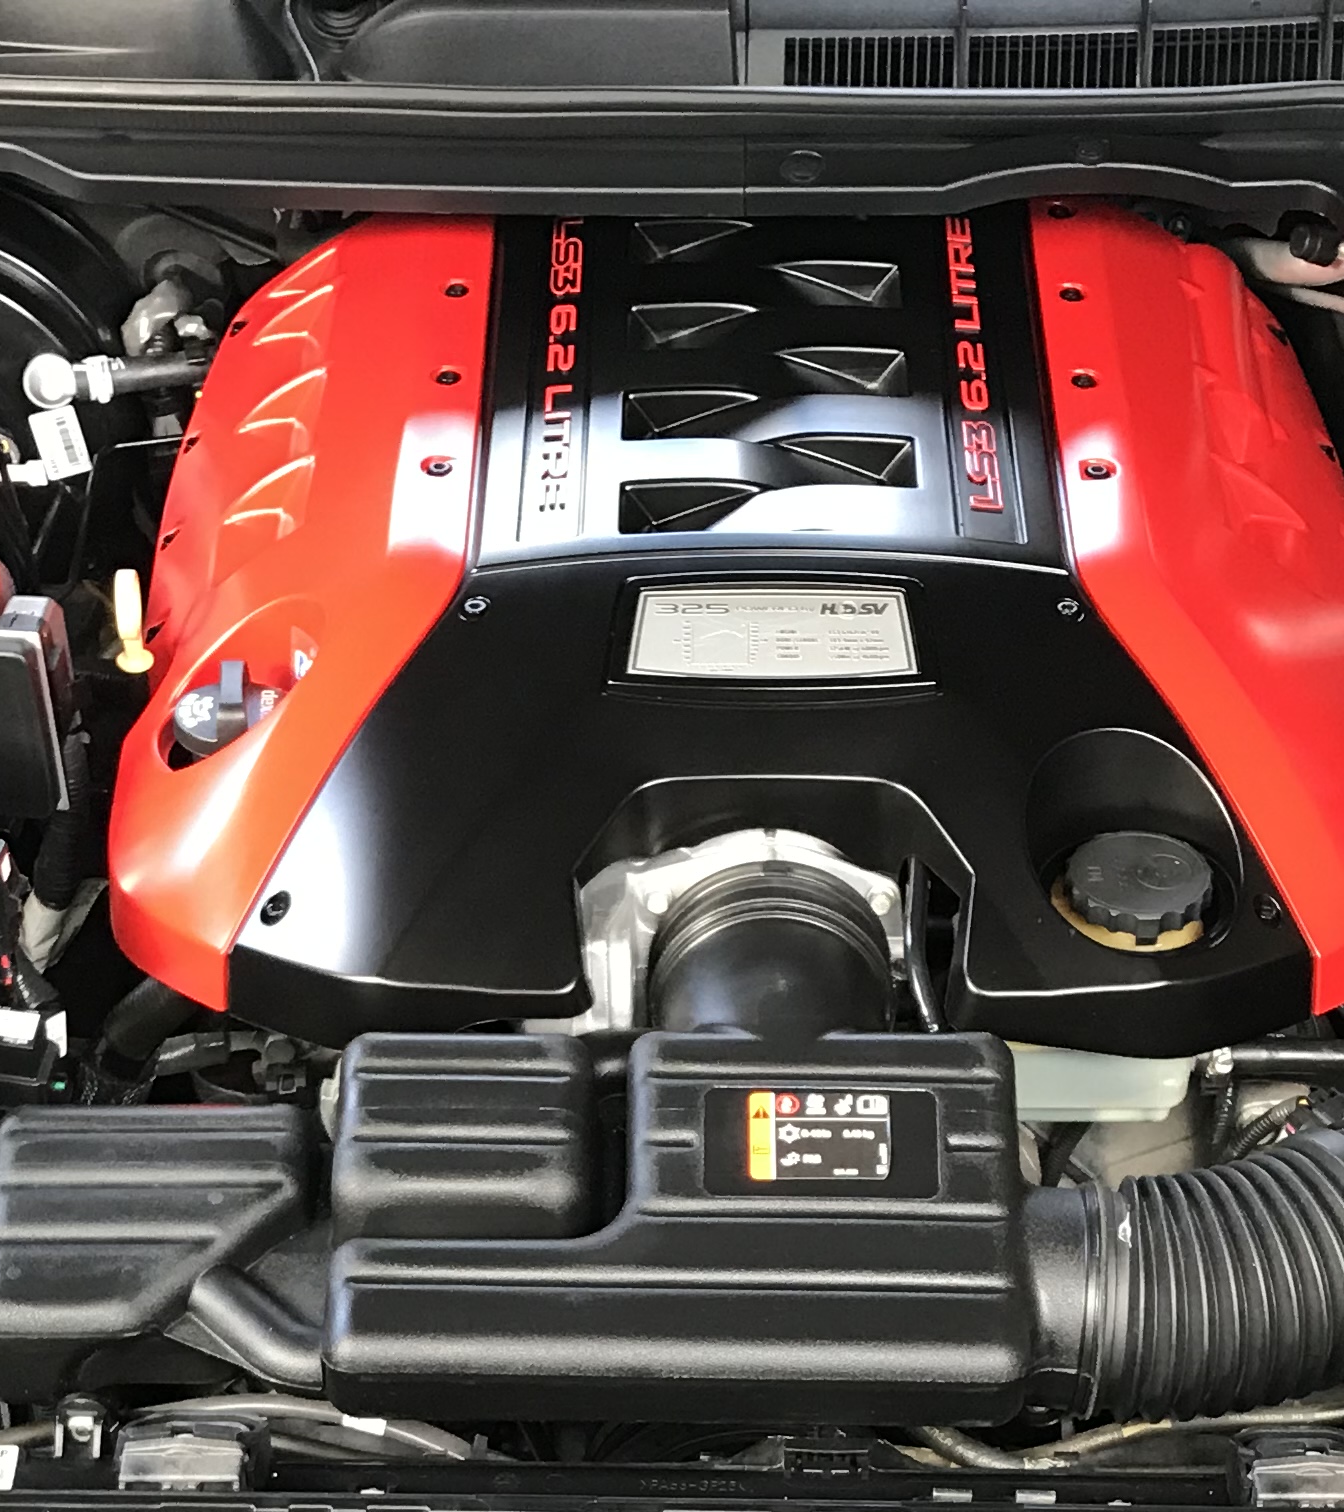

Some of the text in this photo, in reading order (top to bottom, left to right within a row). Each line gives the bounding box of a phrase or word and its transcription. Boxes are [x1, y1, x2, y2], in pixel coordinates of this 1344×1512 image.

[539, 216, 584, 512] LS3 6.2 LITRE
[945, 216, 1004, 512] LS3 6.2 LITRE
[654, 603, 731, 615] 325
